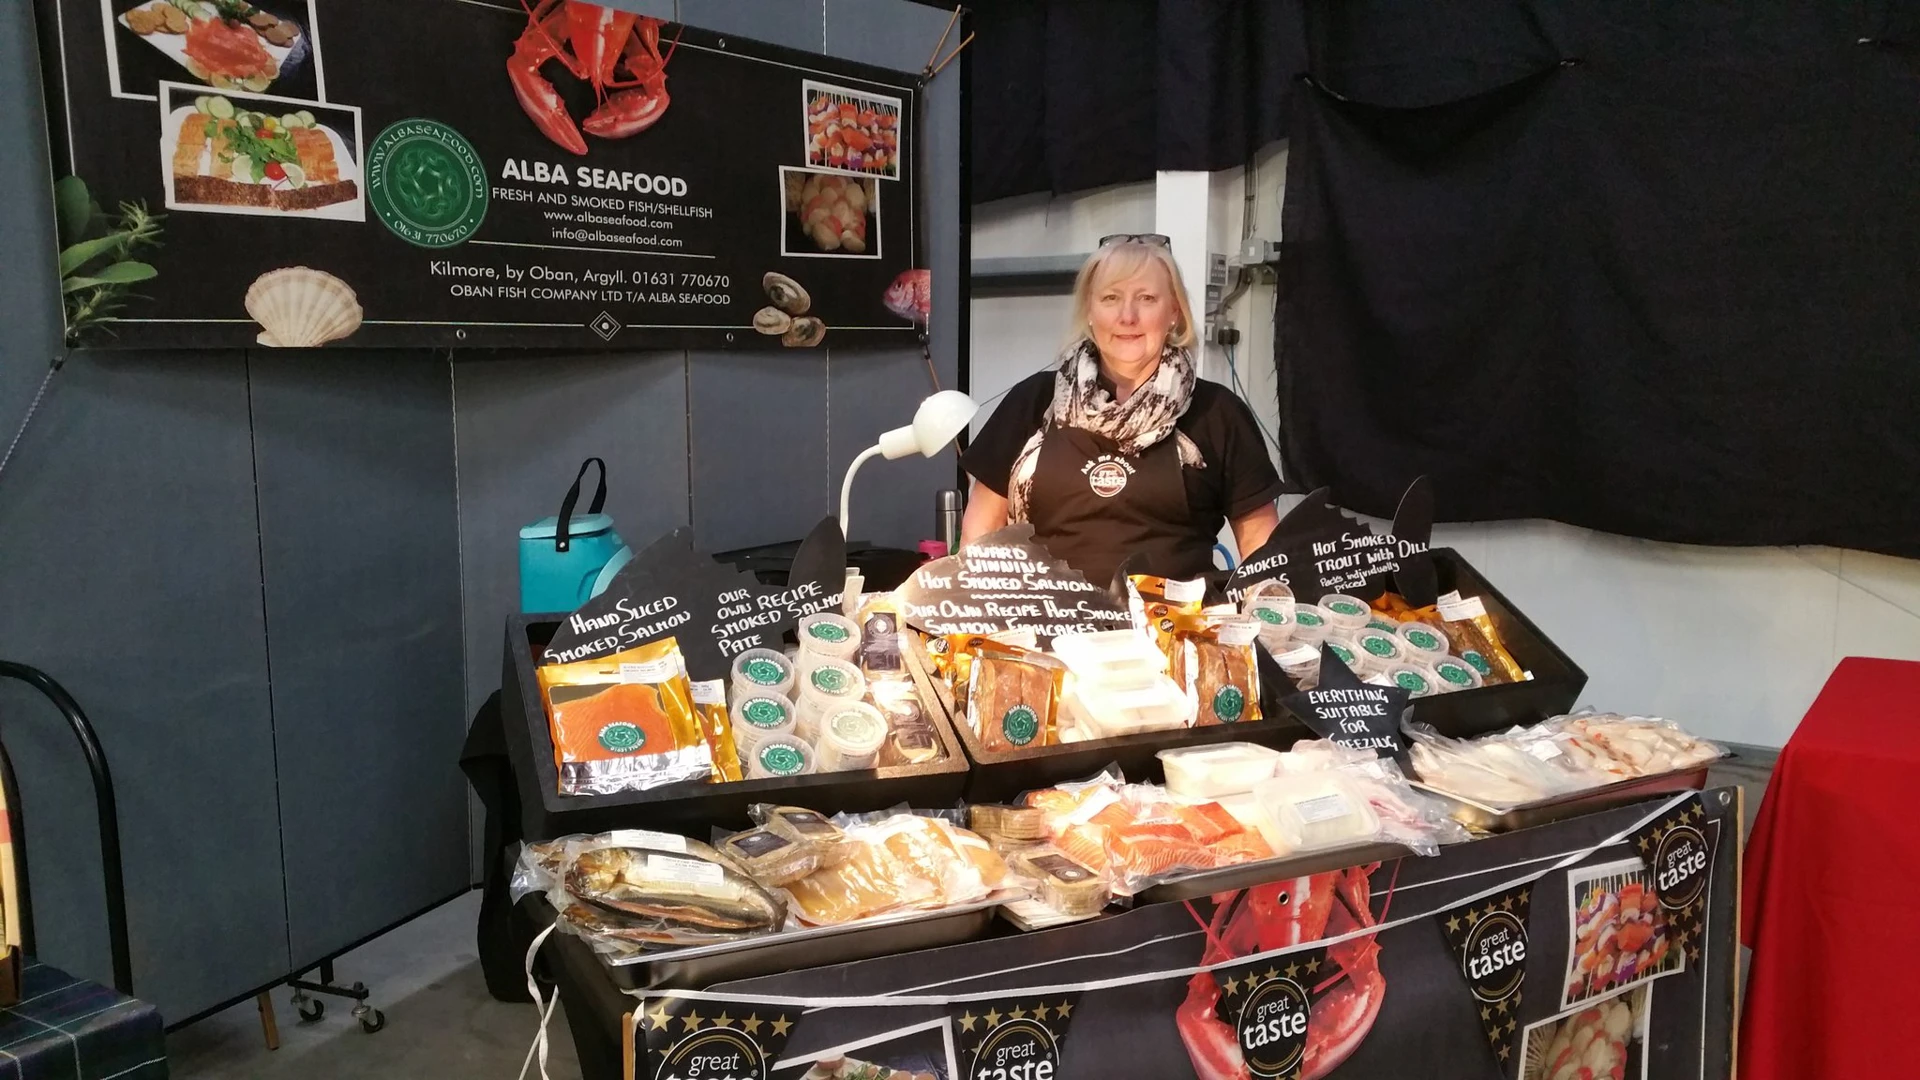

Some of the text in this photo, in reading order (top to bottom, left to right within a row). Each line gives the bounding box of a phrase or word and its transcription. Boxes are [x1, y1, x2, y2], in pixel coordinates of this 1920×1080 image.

[502, 157, 688, 197] ALBA SEAFOOD
[492, 187, 713, 219] FRESH AND SMOKED FISH/SHELLFISH
[543, 209, 674, 230] www.albaseafood.com
[551, 227, 683, 247] info@albaseafood.com
[429, 260, 730, 288] Kilmore, by Oban, Argyll. 01631 770670
[450, 284, 731, 305] OBAN FISH COMPANY LTD T/A ALBA SEAFOOD
[1097, 454, 1112, 463] me
[1113, 456, 1136, 475] about
[1237, 553, 1288, 579] SMOKED
[1314, 552, 1362, 574] TROUT
[718, 634, 762, 658] PATE
[1308, 688, 1389, 705] EVERYTHING
[1315, 703, 1387, 719] SUITABLE
[1339, 717, 1370, 734] FOR
[1667, 840, 1693, 869] great
[1658, 851, 1706, 891] taste
[1480, 927, 1510, 955] great
[1469, 941, 1526, 980] taste
[1257, 995, 1290, 1023] great
[1243, 1012, 1307, 1049] taste
[688, 1052, 740, 1077] great
[995, 1040, 1036, 1067] great
